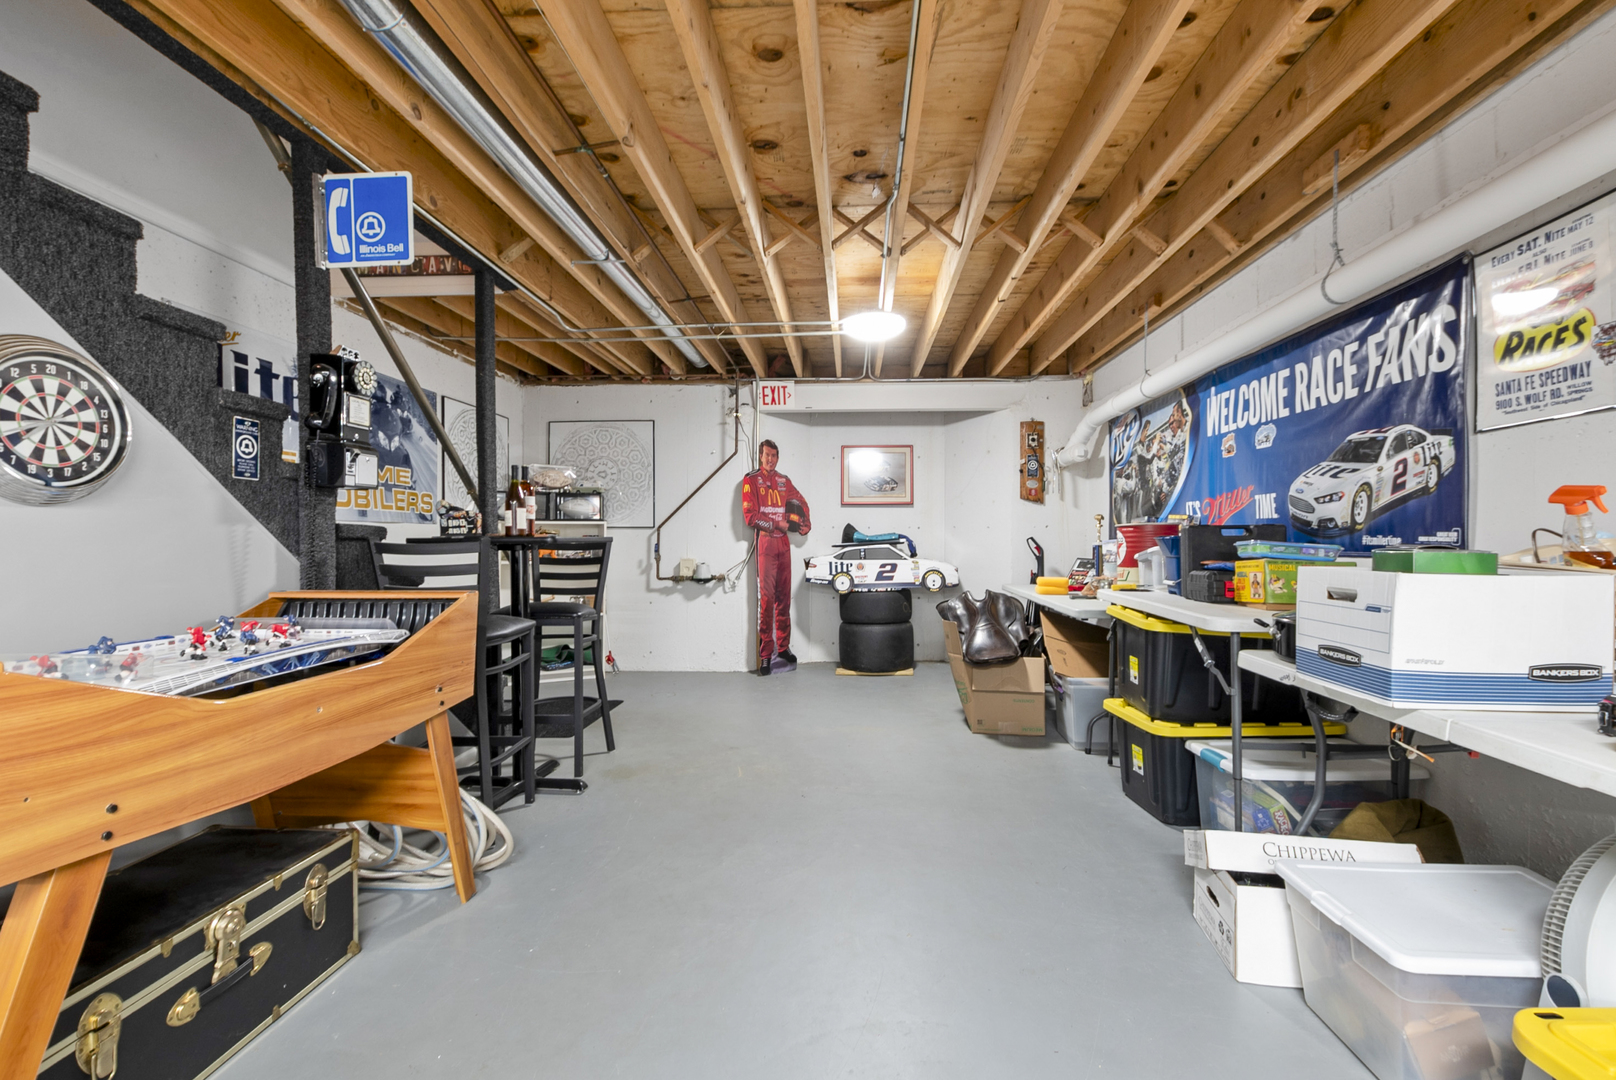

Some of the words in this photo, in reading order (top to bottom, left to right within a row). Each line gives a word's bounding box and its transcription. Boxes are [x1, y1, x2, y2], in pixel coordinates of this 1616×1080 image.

[1491, 250, 1515, 268] EVERY
[1517, 236, 1542, 256] SAT.
[1544, 227, 1566, 244] NITE
[1567, 221, 1583, 234] MAY
[1585, 216, 1594, 226] 12
[359, 244, 386, 254] Illinois
[387, 243, 404, 252] Bell
[1543, 250, 1566, 265] NITE
[1569, 242, 1587, 256] JUNE
[1499, 315, 1588, 365] RACES
[10, 367, 19, 378] 12
[31, 364, 37, 374] 5
[46, 364, 56, 375] 20
[1207, 368, 1290, 437] WELCOME
[1295, 341, 1360, 414] RACE
[1364, 304, 1457, 393] FANS
[66, 371, 71, 380] 1
[1495, 378, 1522, 397] SANTA
[1524, 375, 1536, 391] FE
[1539, 360, 1592, 388] SPEEDWAY
[80, 381, 88, 391] 18
[1567, 387, 1593, 396] SPRINGS
[93, 395, 99, 405] 4
[762, 385, 788, 405] EXIT
[1495, 398, 1513, 410] 9100
[1515, 396, 1522, 407] S.
[1524, 390, 1547, 405] WOLF
[1550, 387, 1564, 400] RD.
[1566, 381, 1592, 389] WILLOW
[100, 410, 108, 419] 13
[102, 424, 108, 434] 6
[100, 439, 108, 448] 10
[10, 455, 16, 465] 7
[93, 452, 101, 462] 15
[27, 464, 36, 474] 19
[64, 467, 72, 477] 17
[82, 462, 87, 471] 2
[1302, 464, 1361, 479] Lite
[47, 468, 53, 478] 3
[378, 465, 412, 485] ME
[1390, 457, 1408, 496] 2
[1185, 500, 1201, 517] IT'S
[1201, 485, 1255, 525] Miller
[874, 562, 898, 581] 2
[1268, 564, 1296, 572] MUSICAL
[1320, 648, 1346, 661] BANKERS
[1345, 655, 1359, 663] BOX
[1532, 669, 1579, 677] BANKERS
[1580, 669, 1599, 677] BOX
[1262, 842, 1357, 863] CHIPPEWA
